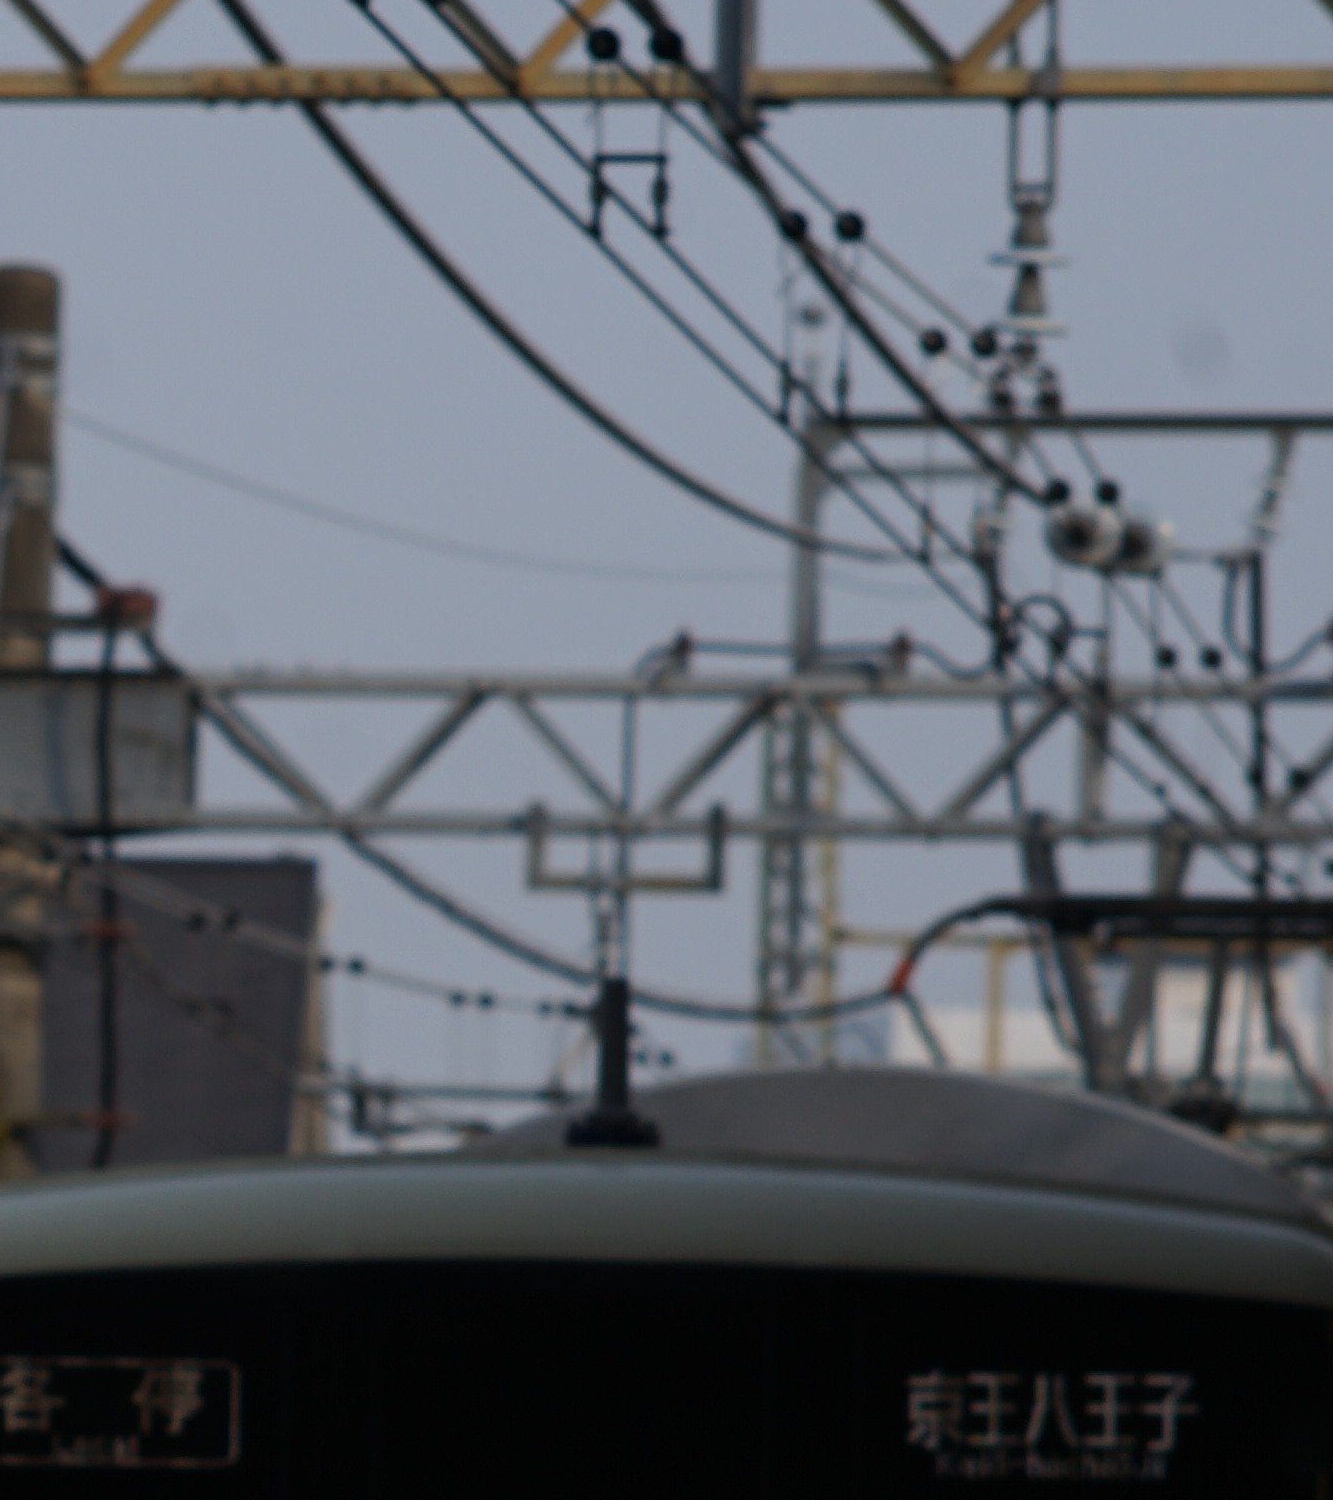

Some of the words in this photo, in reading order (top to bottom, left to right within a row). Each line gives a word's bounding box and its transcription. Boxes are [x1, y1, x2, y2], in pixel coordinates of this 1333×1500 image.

[903, 1367, 1201, 1451] 京王八王子
